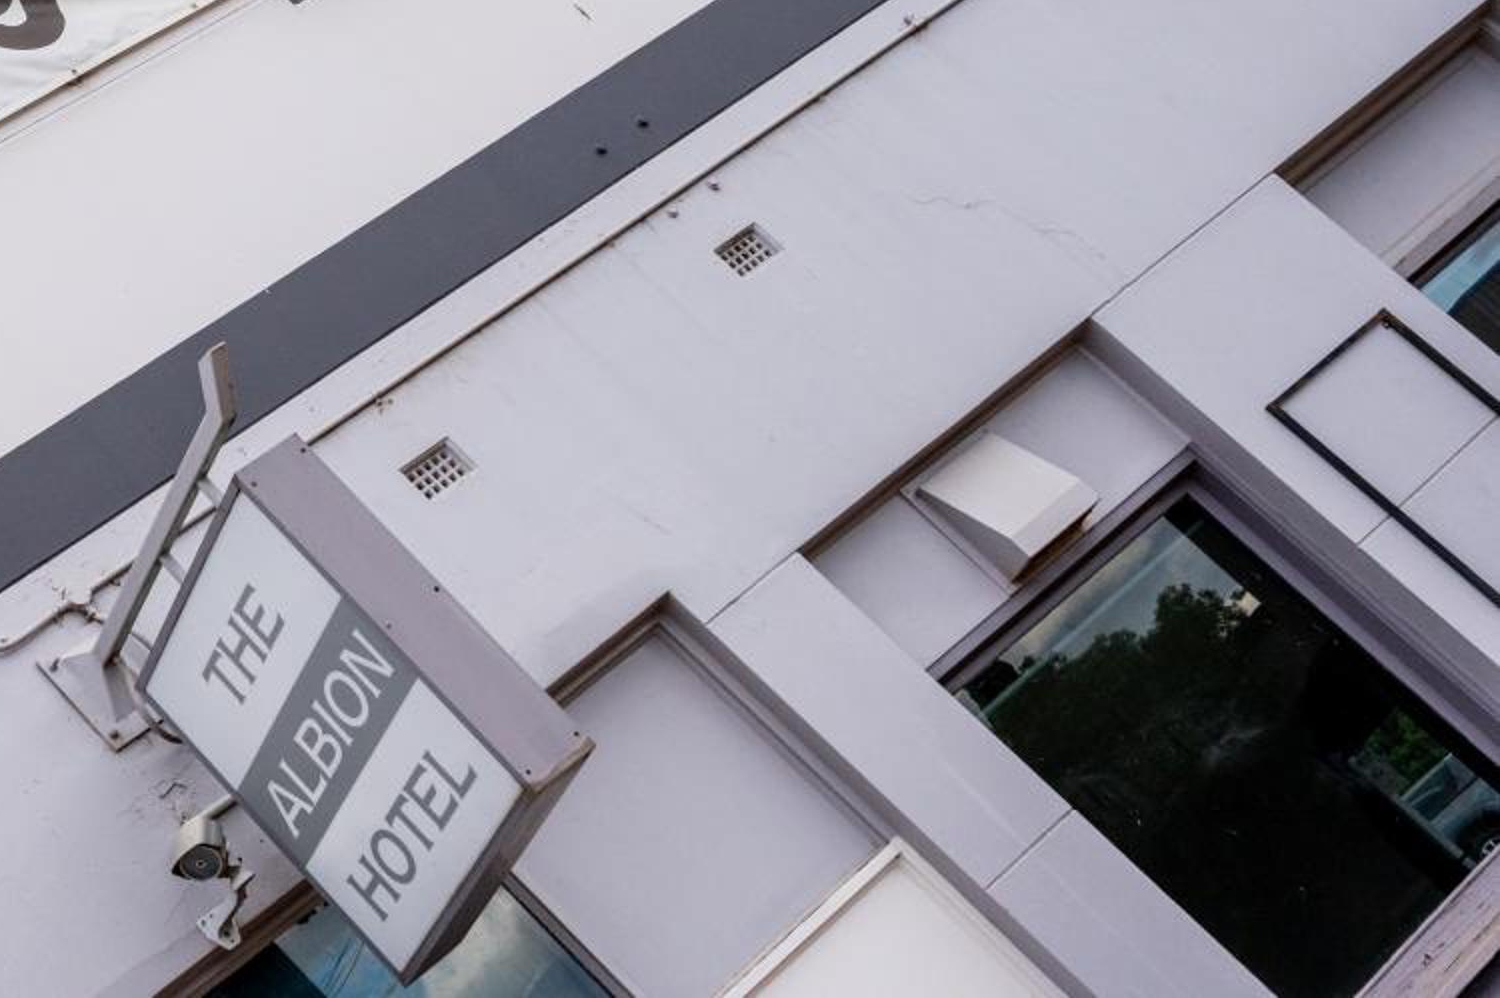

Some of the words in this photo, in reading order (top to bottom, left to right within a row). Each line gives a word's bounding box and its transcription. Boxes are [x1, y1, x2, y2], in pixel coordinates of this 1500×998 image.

[202, 583, 285, 705] THE
[263, 627, 394, 838] ALBION
[346, 748, 477, 922] HOTEL
